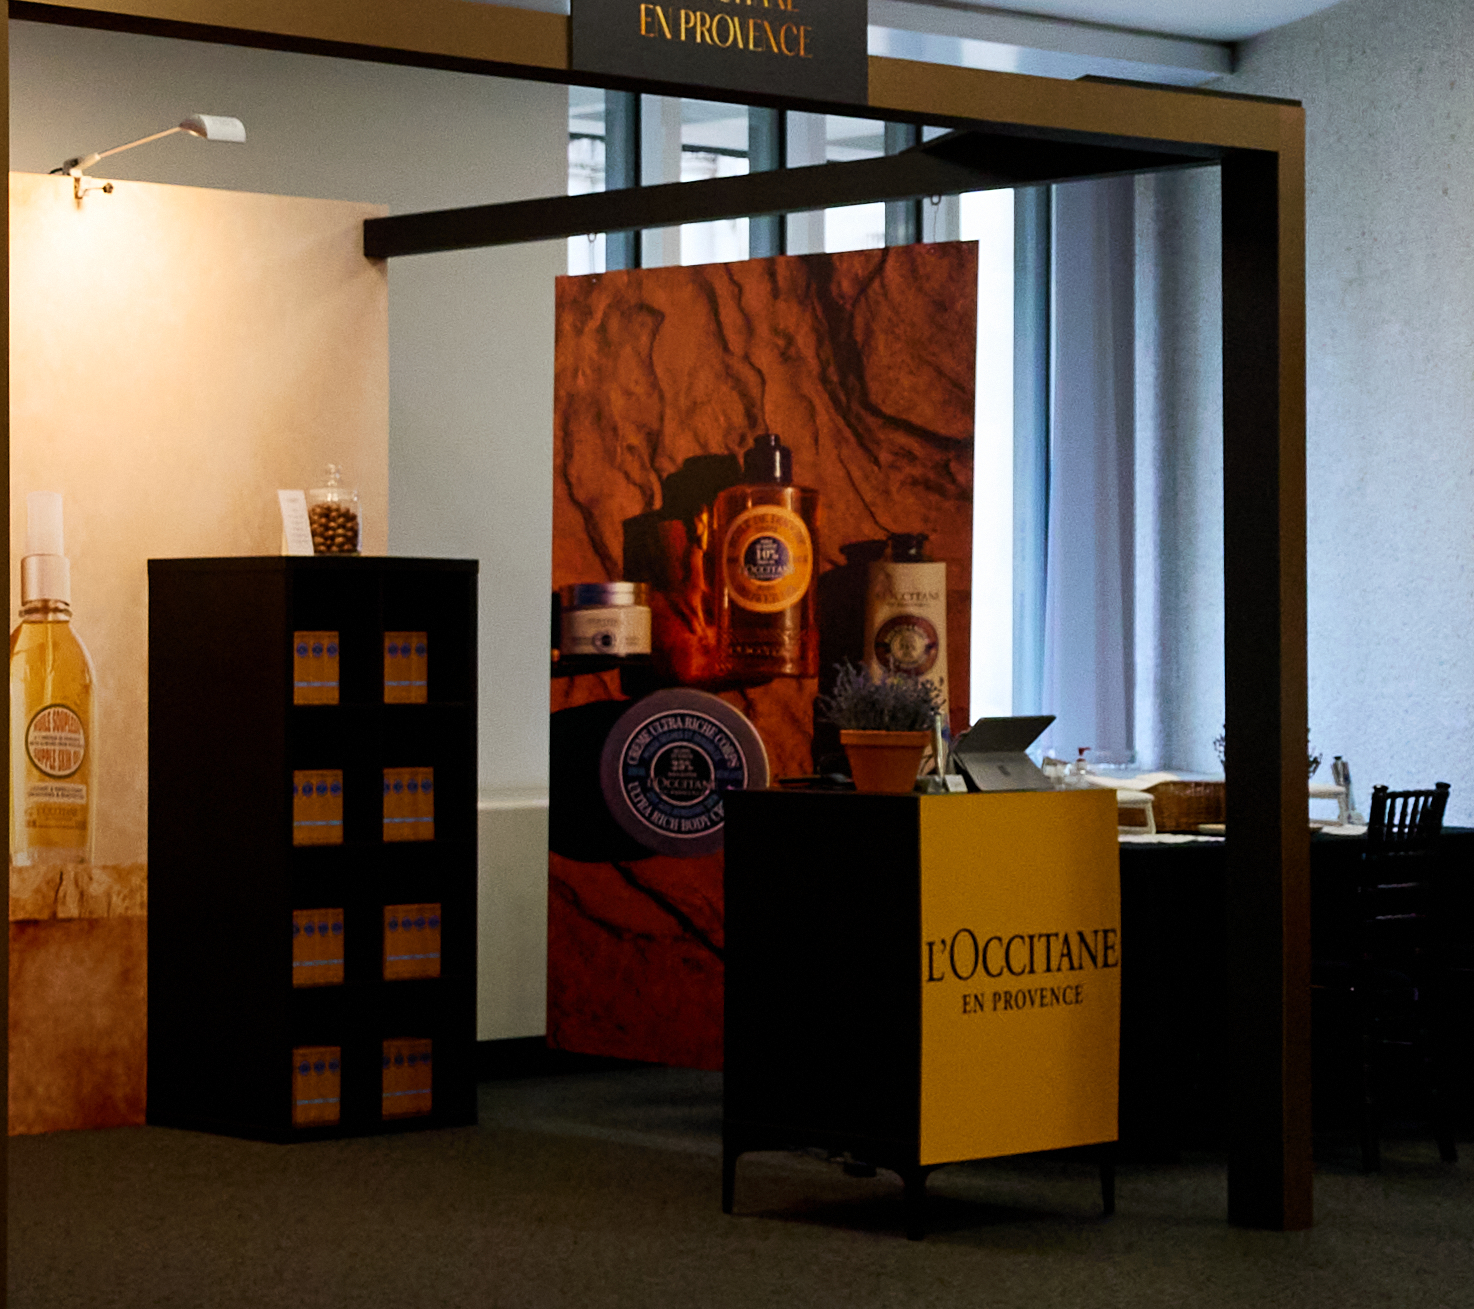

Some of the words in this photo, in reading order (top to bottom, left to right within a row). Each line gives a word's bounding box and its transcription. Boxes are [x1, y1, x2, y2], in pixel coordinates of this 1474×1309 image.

[639, 3, 672, 39] EN
[680, 9, 813, 58] PROVENCE
[650, 717, 683, 735] ULTRA
[685, 717, 718, 739] RICHE
[627, 781, 653, 818] ULTRA
[650, 810, 679, 831] RICH
[681, 815, 711, 831] BODY
[926, 928, 1118, 982] L'OCCITANE
[962, 993, 984, 1014] EN
[992, 985, 1083, 1011] PROVENCE
